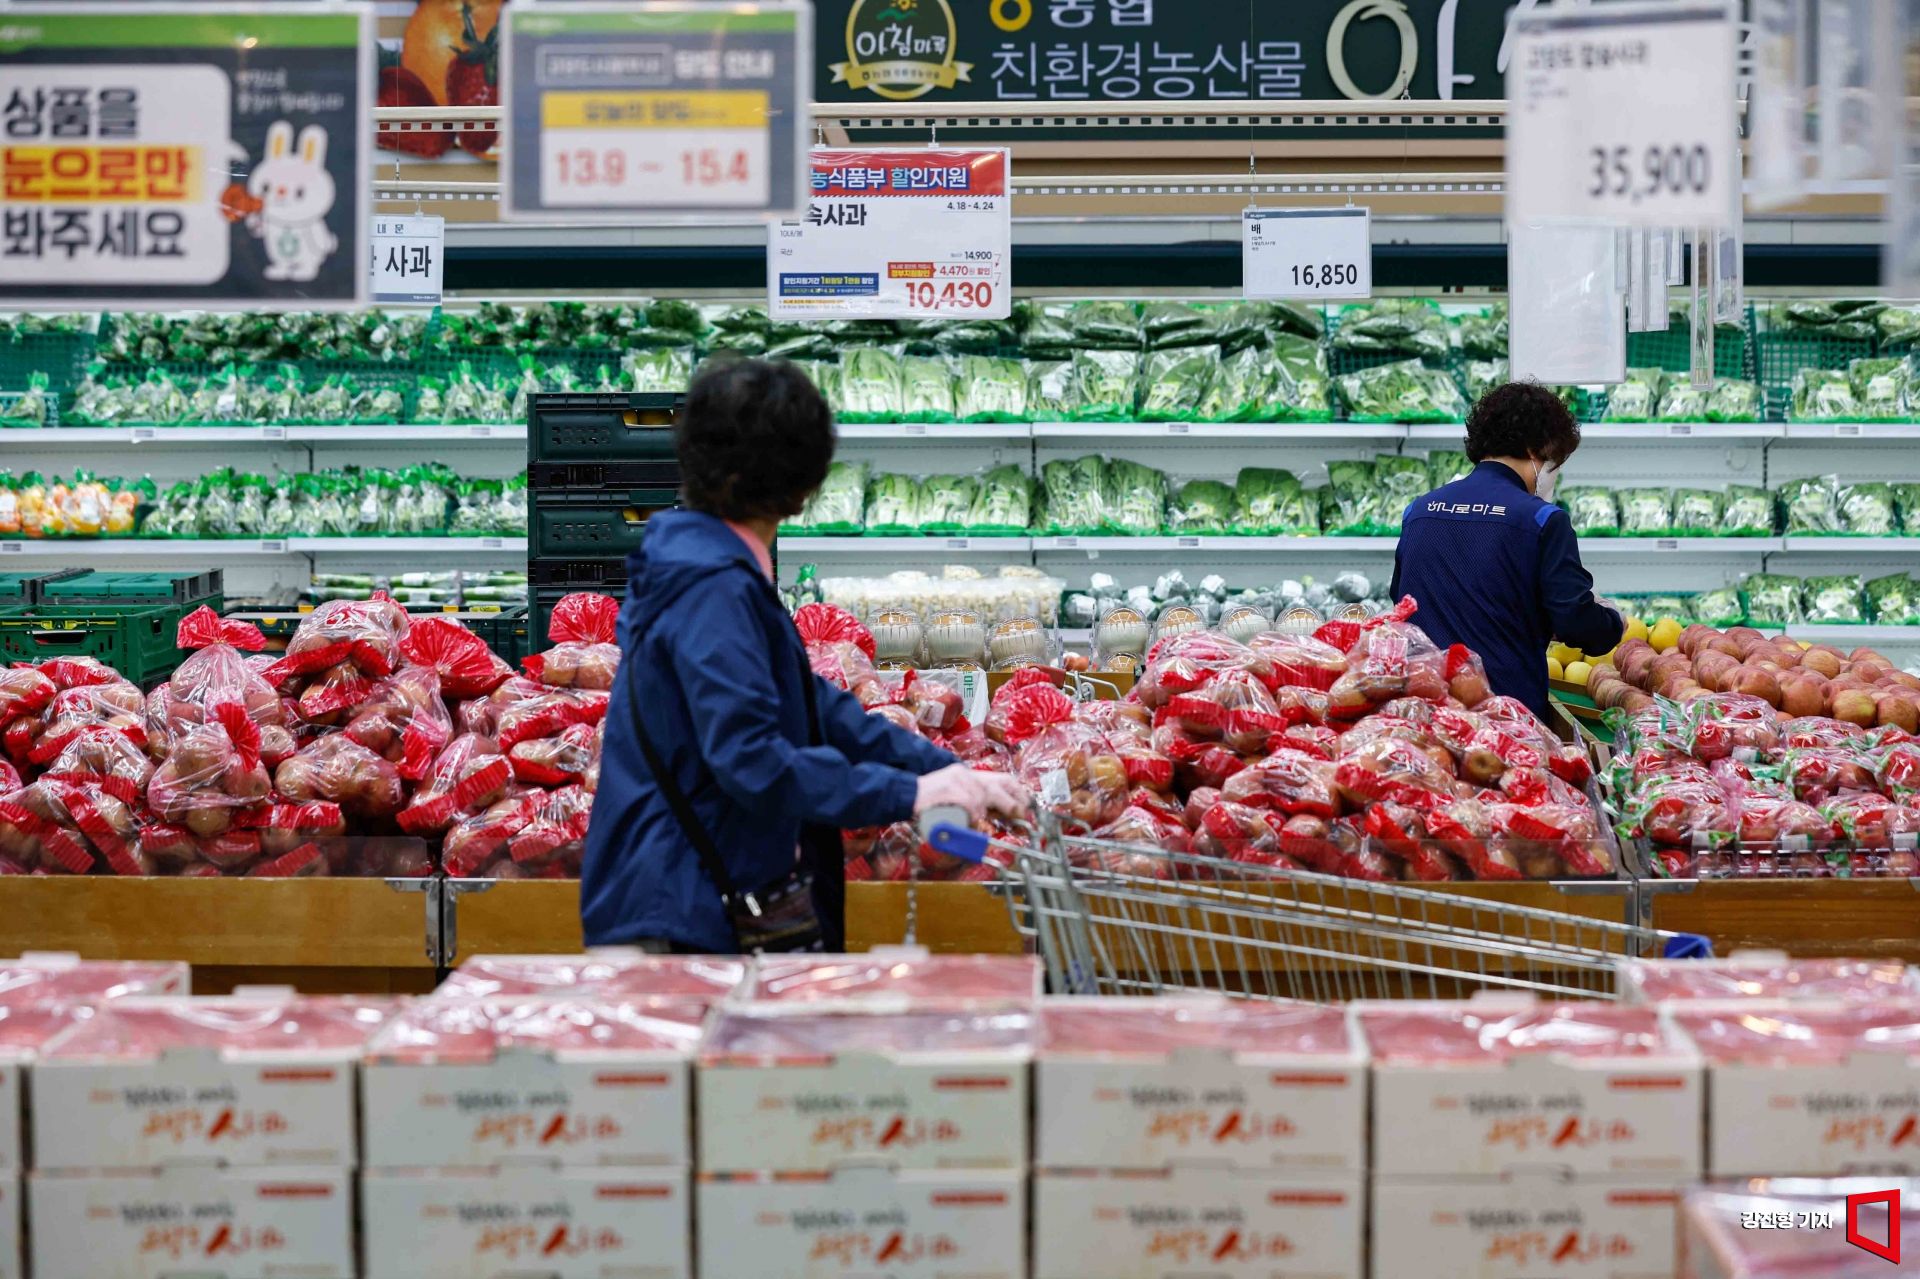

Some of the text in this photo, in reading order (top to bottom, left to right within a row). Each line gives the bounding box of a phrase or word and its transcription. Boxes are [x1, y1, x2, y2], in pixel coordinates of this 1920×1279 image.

[990, 41, 1306, 99] 친환경농산물
[4, 86, 138, 138] 상품을
[4, 148, 190, 199] 눈으로만
[810, 167, 968, 189] 농식품부 할인지원
[1589, 145, 1711, 202] 35,900
[4, 210, 187, 258] 봐주세요
[1251, 223, 1261, 235] 배
[385, 245, 432, 278] 사과
[1291, 264, 1358, 289] 16,850
[905, 281, 993, 310] 10,430
[1427, 500, 1507, 516] 하나로마트
